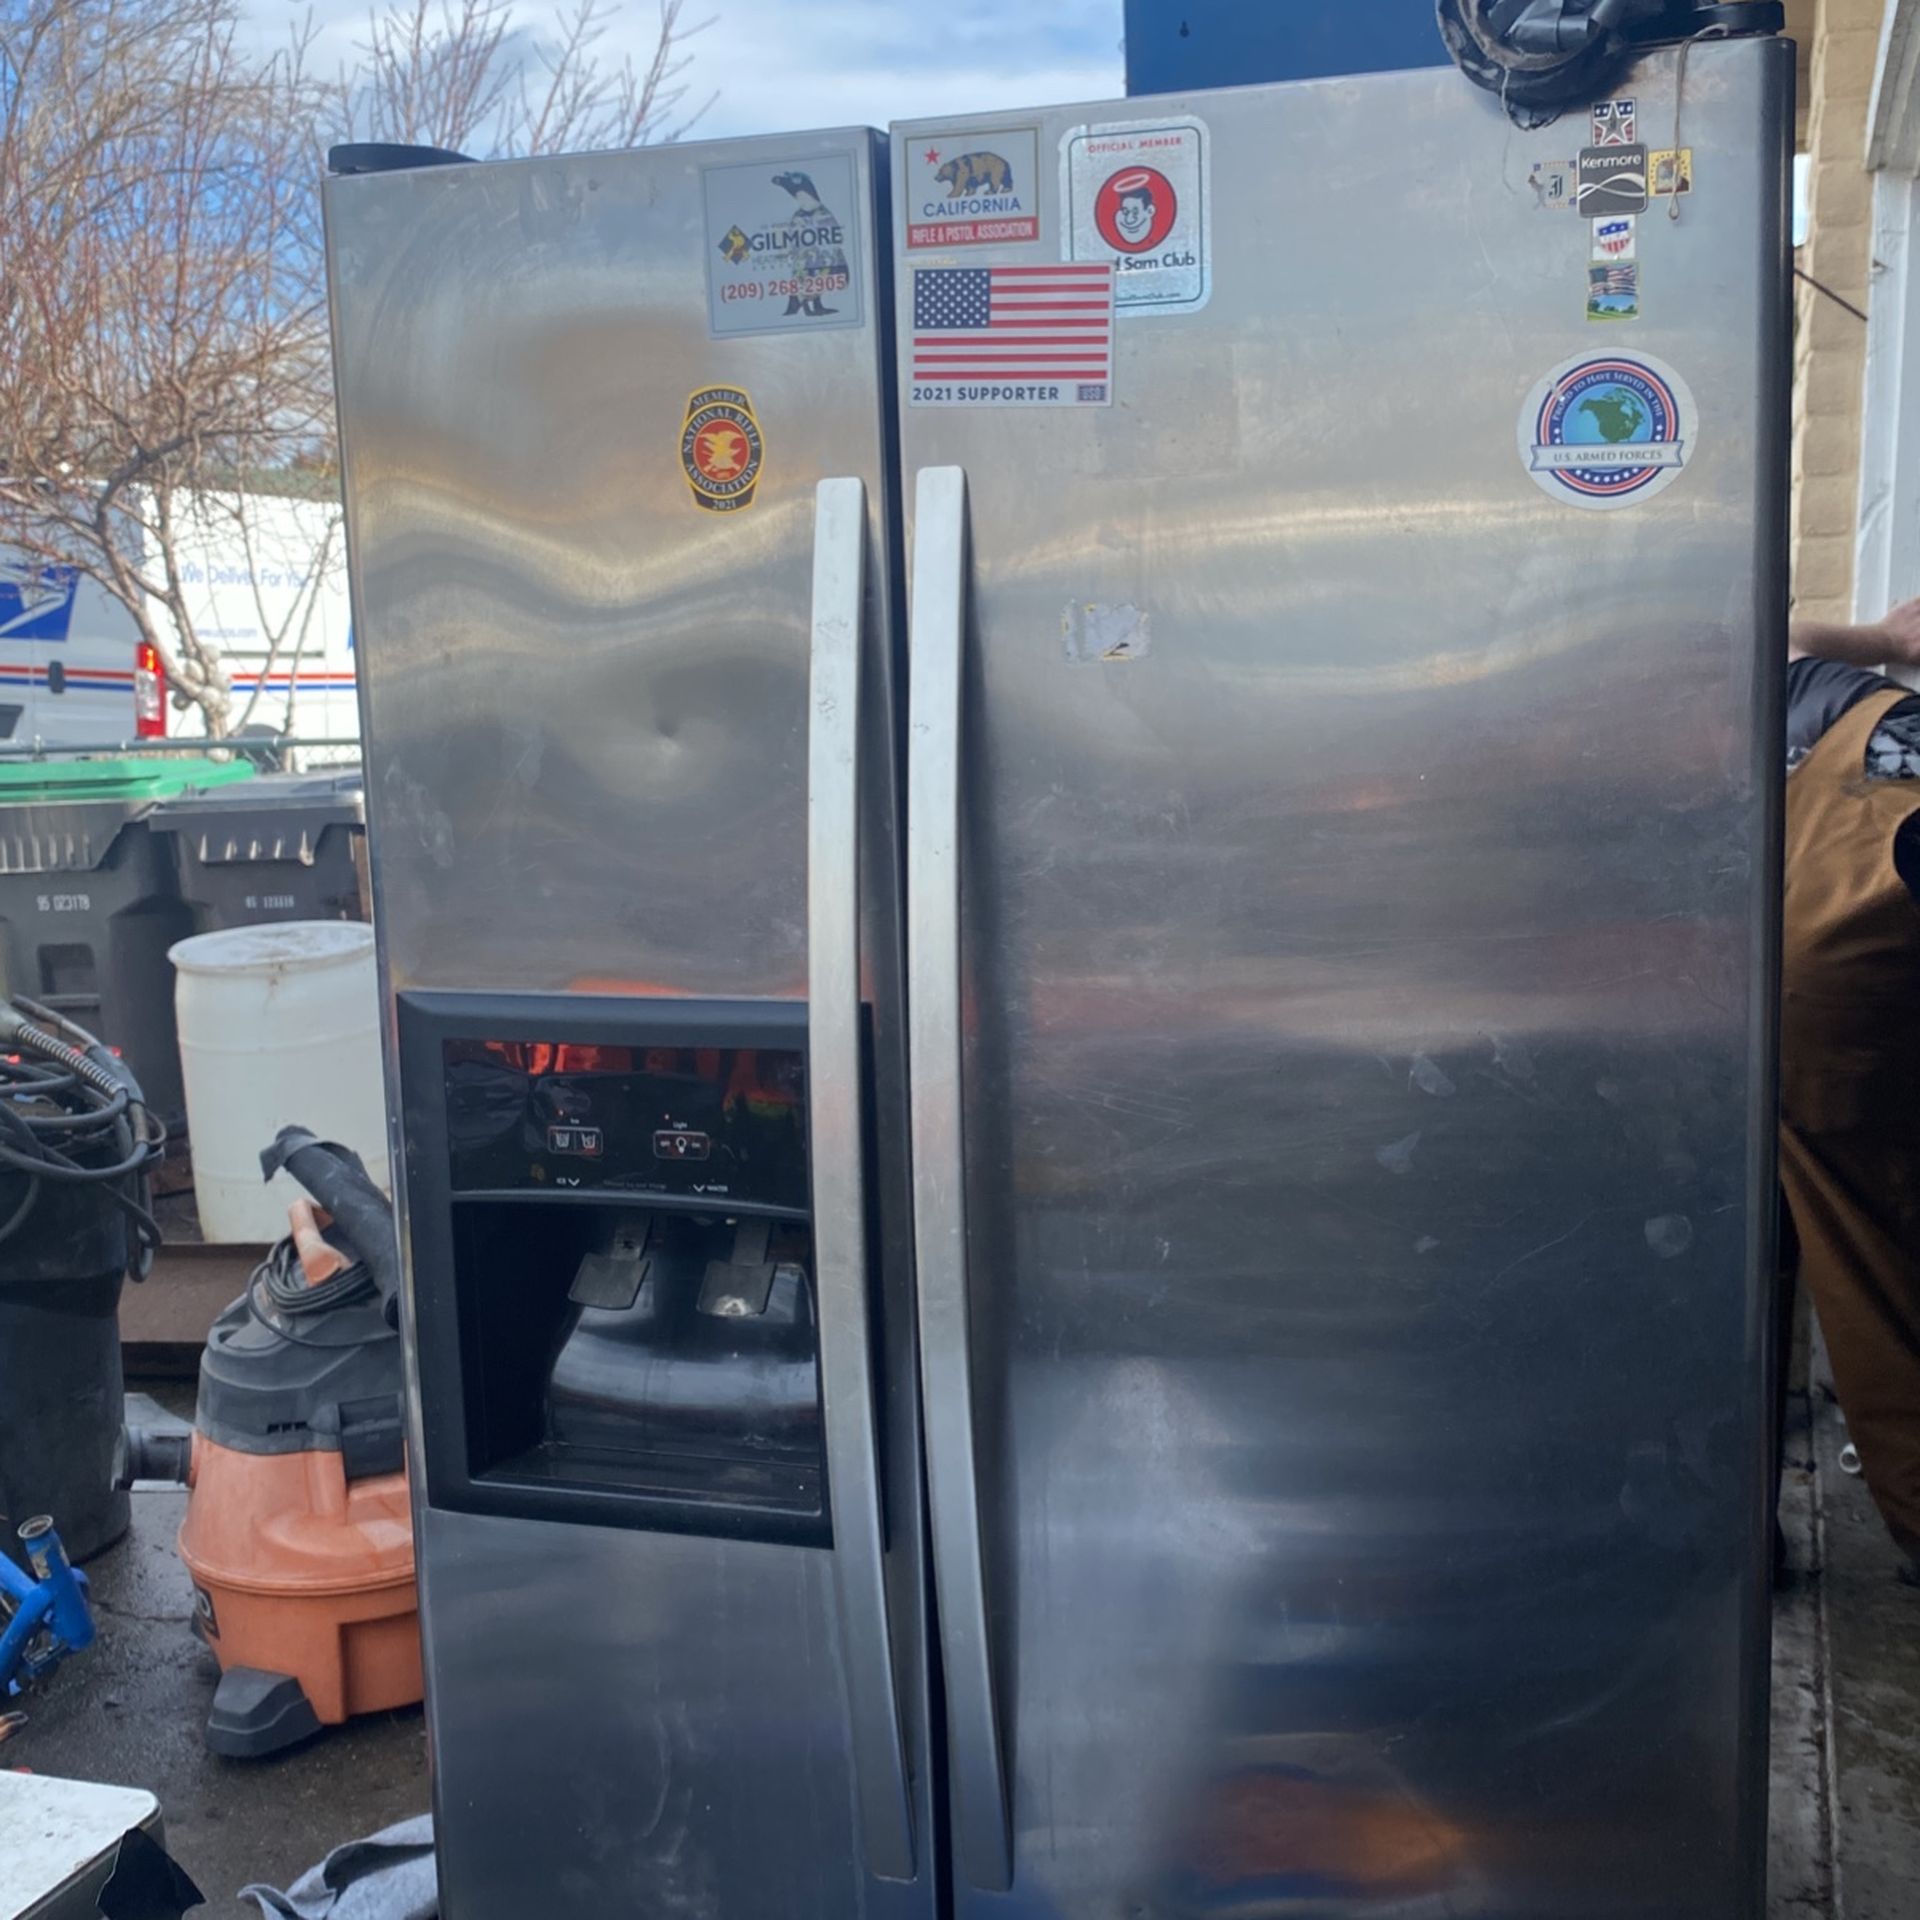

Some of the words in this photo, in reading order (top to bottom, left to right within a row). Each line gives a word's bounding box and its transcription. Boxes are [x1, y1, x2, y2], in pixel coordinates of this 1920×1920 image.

[1088, 142, 1133, 154] OFFICIAL
[1139, 137, 1182, 148] MEMBER
[1581, 154, 1642, 169] Kenmore
[923, 197, 1021, 217] CALIFORNIA
[751, 226, 843, 252] GILMORE
[976, 221, 1033, 240] ASSOCIATION
[1125, 256, 1158, 271] Sam
[1162, 252, 1196, 267] Club
[721, 282, 764, 304] (209)
[1613, 372, 1645, 390] SERVED
[912, 387, 952, 401] 2021
[957, 386, 1060, 401] SUPPORTER
[1553, 453, 1573, 463] U.S.
[1575, 451, 1617, 462] ARMED
[1618, 450, 1663, 461] FORCES
[687, 461, 758, 493] ASSOCIATION
